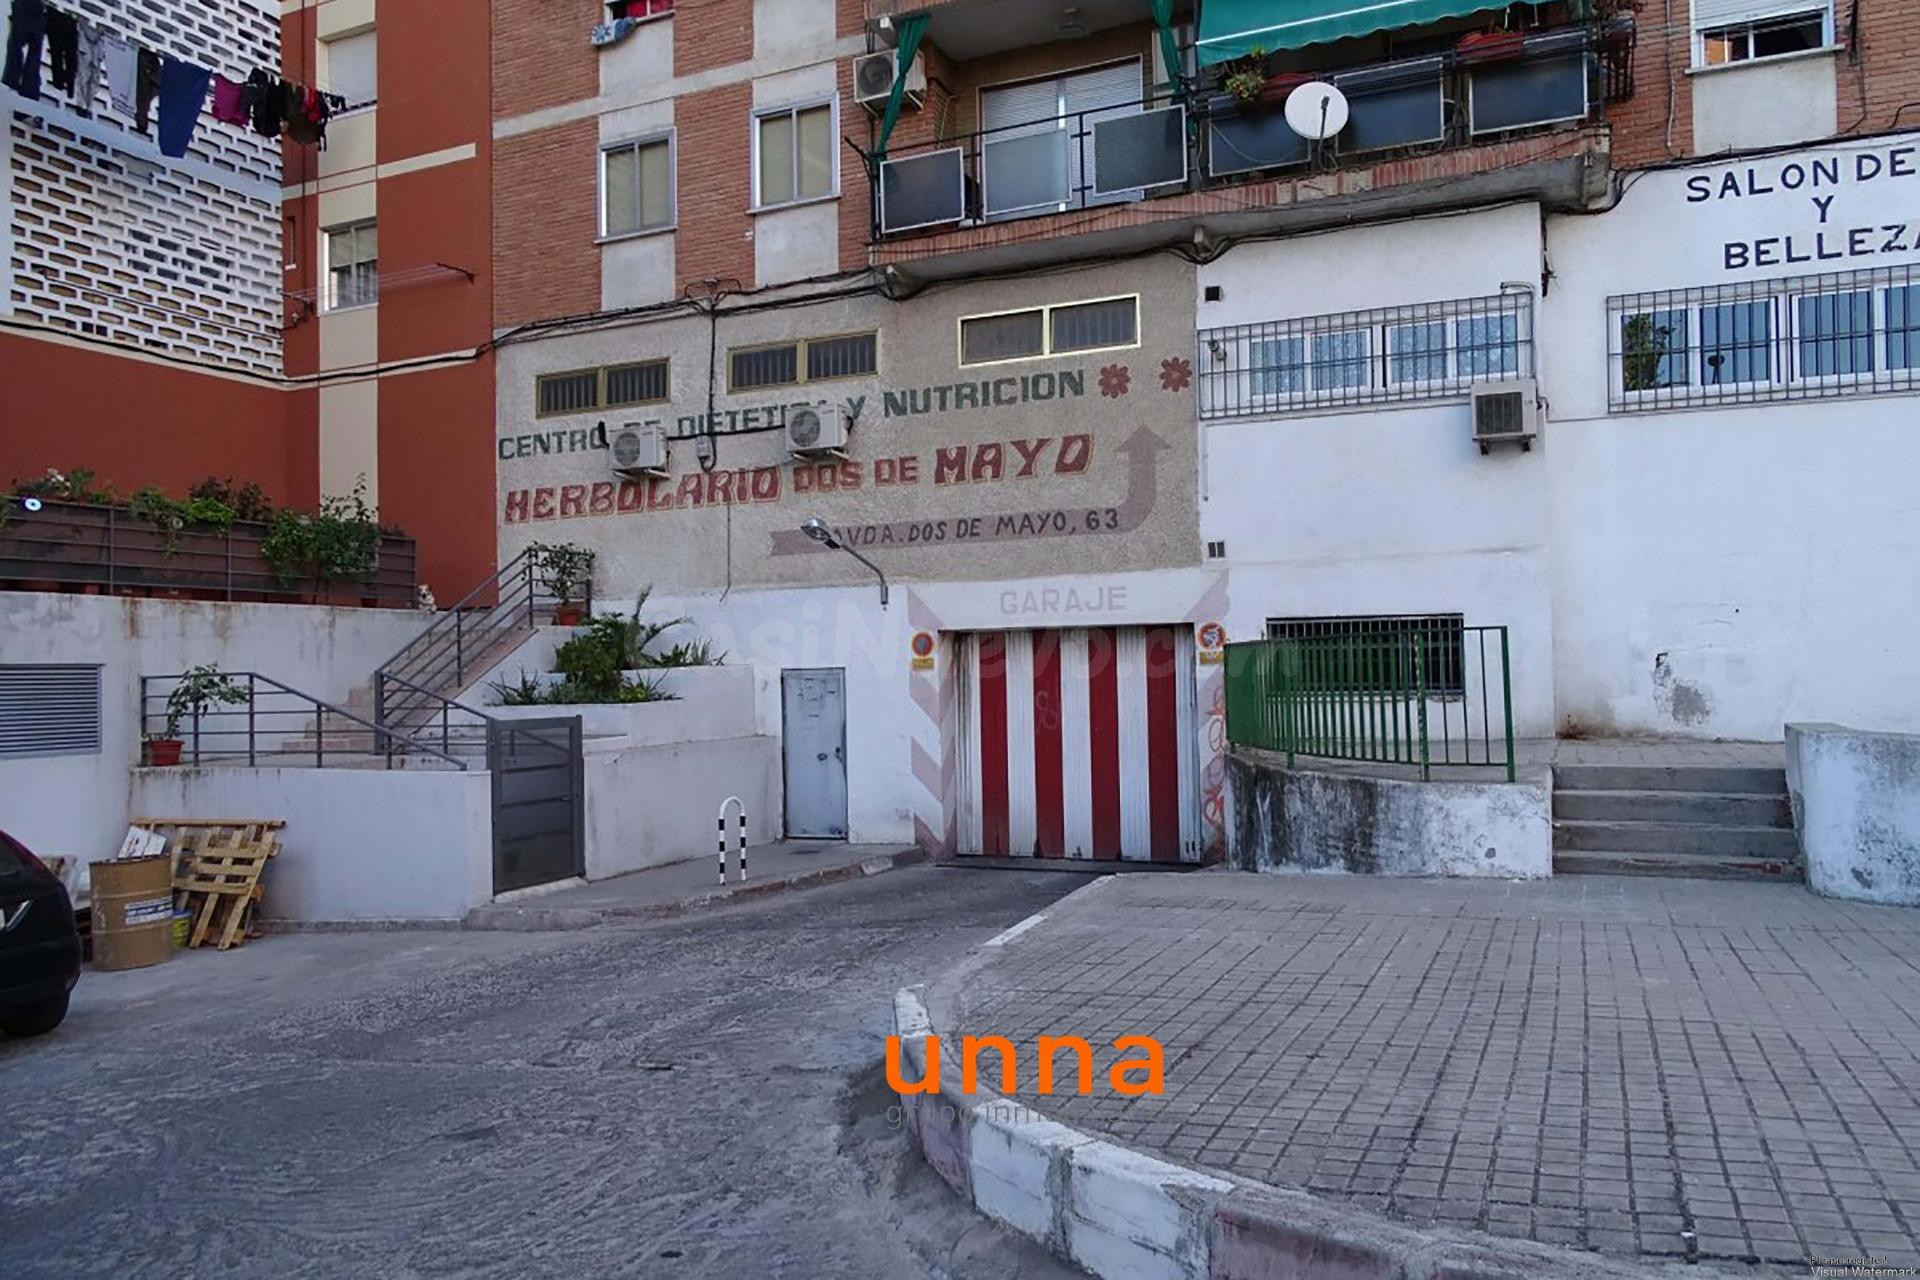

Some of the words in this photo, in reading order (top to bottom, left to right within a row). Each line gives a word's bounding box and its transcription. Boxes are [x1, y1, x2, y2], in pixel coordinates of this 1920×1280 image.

[1686, 157, 1839, 202] SALON
[1856, 146, 1916, 181] DE
[1811, 194, 1835, 223] Y
[498, 424, 610, 460] CENTRO
[677, 400, 828, 438] DIETETI
[845, 395, 868, 420] Y
[883, 369, 1085, 418] NUTRICION
[504, 465, 783, 525] HERBOLARIO
[792, 460, 862, 493] DOS
[873, 456, 919, 488] DE
[934, 432, 1096, 487] MAYO
[908, 521, 948, 543] DOS
[956, 518, 983, 539] DE
[994, 511, 1077, 536] MAYO,
[1085, 508, 1119, 531] 63
[1000, 585, 1128, 615] GARAJE
